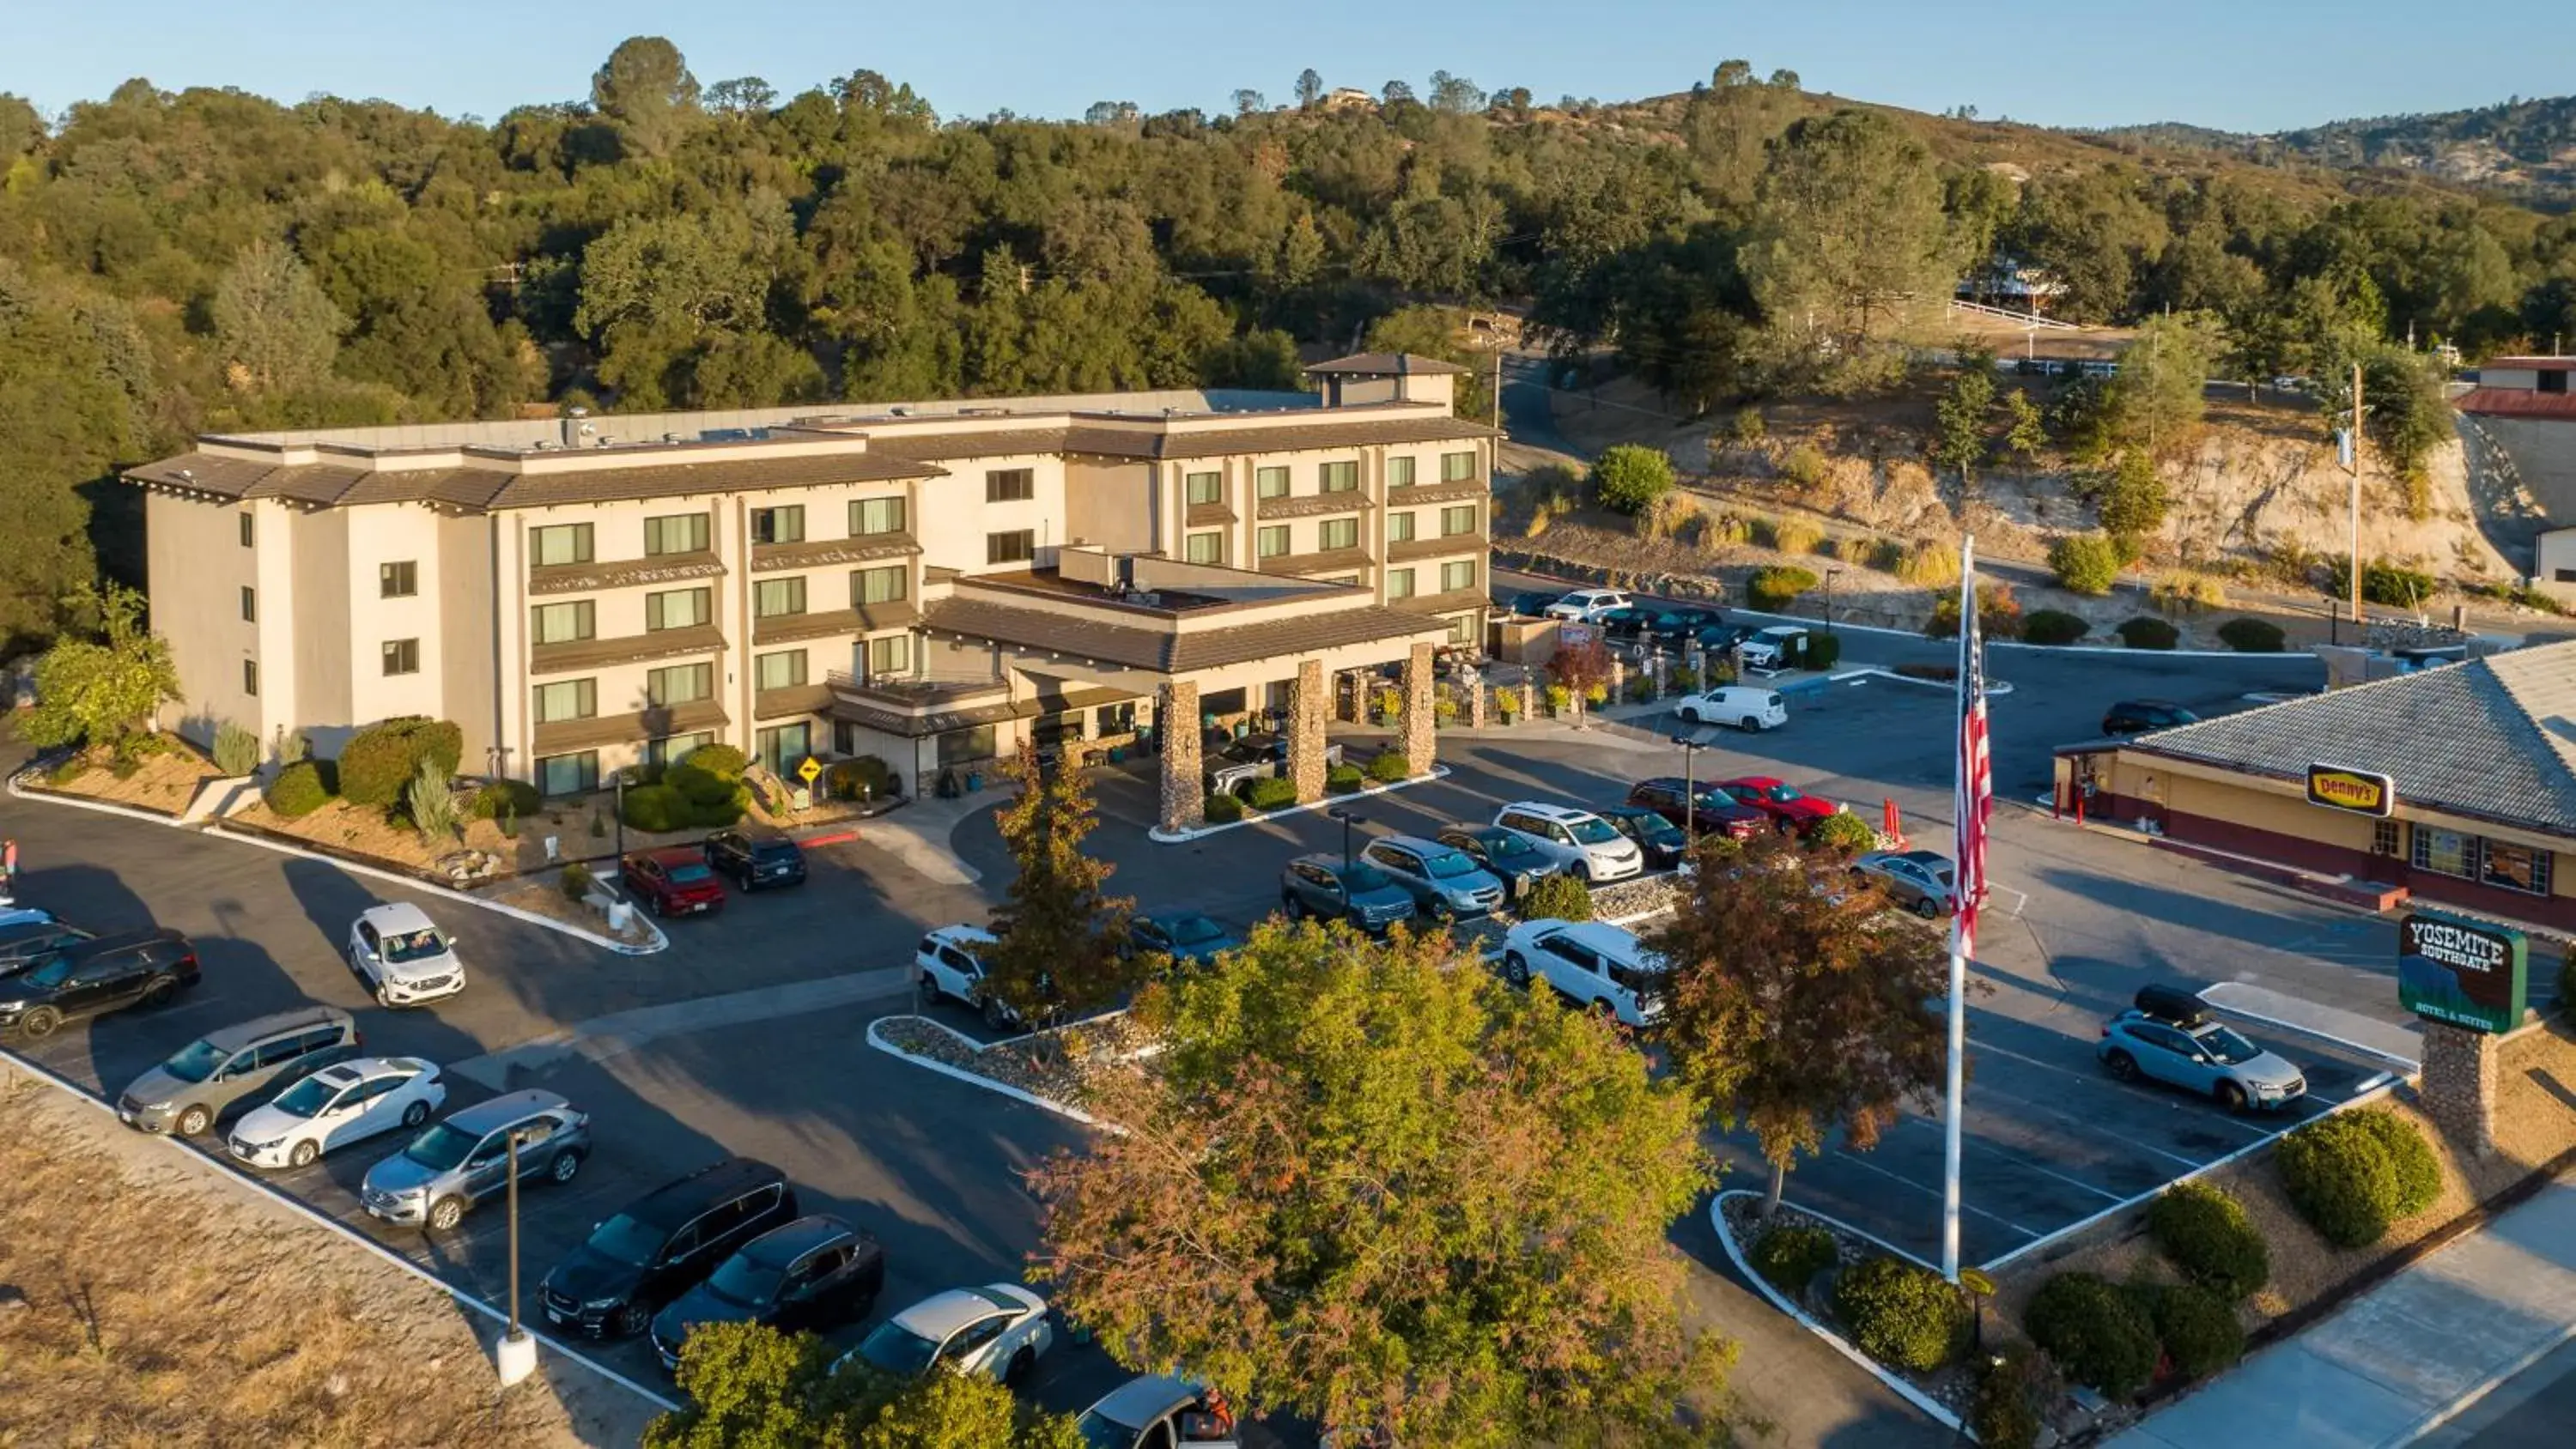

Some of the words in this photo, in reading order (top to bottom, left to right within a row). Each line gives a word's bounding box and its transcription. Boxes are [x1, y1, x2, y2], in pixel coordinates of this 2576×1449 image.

[2320, 778, 2372, 801] Denny's
[2410, 923, 2504, 966] YOSEMITE
[2421, 943, 2491, 973] SOUTHGATE
[2415, 1002, 2447, 1018] HOTEL
[2458, 1014, 2494, 1030] SUITES
